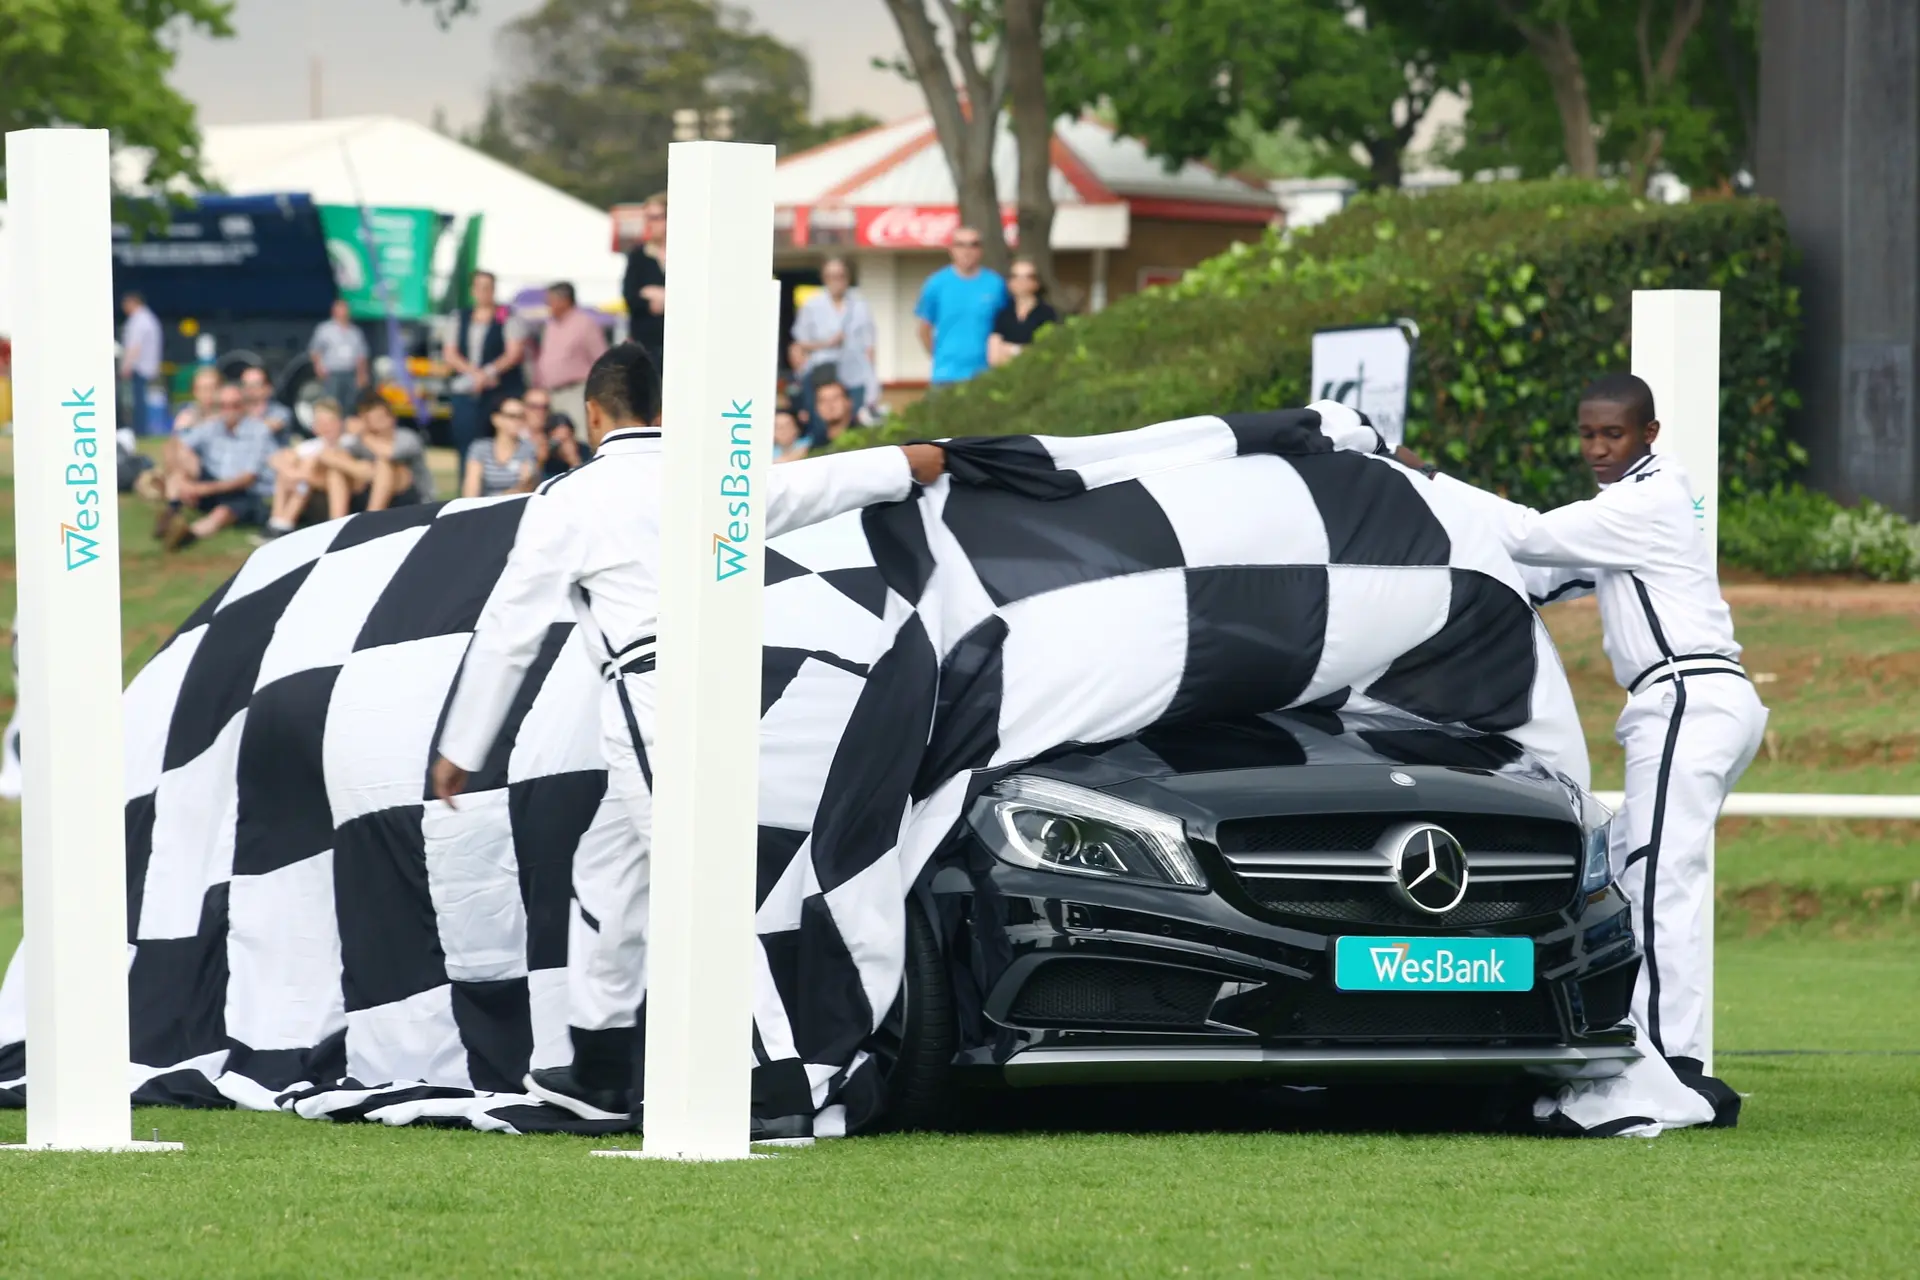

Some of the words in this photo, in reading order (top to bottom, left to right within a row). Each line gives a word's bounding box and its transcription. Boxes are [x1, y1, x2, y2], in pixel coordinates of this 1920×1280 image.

[60, 386, 100, 571] WesBank
[713, 399, 752, 582] WesBank
[1369, 942, 1505, 983] WesBank
